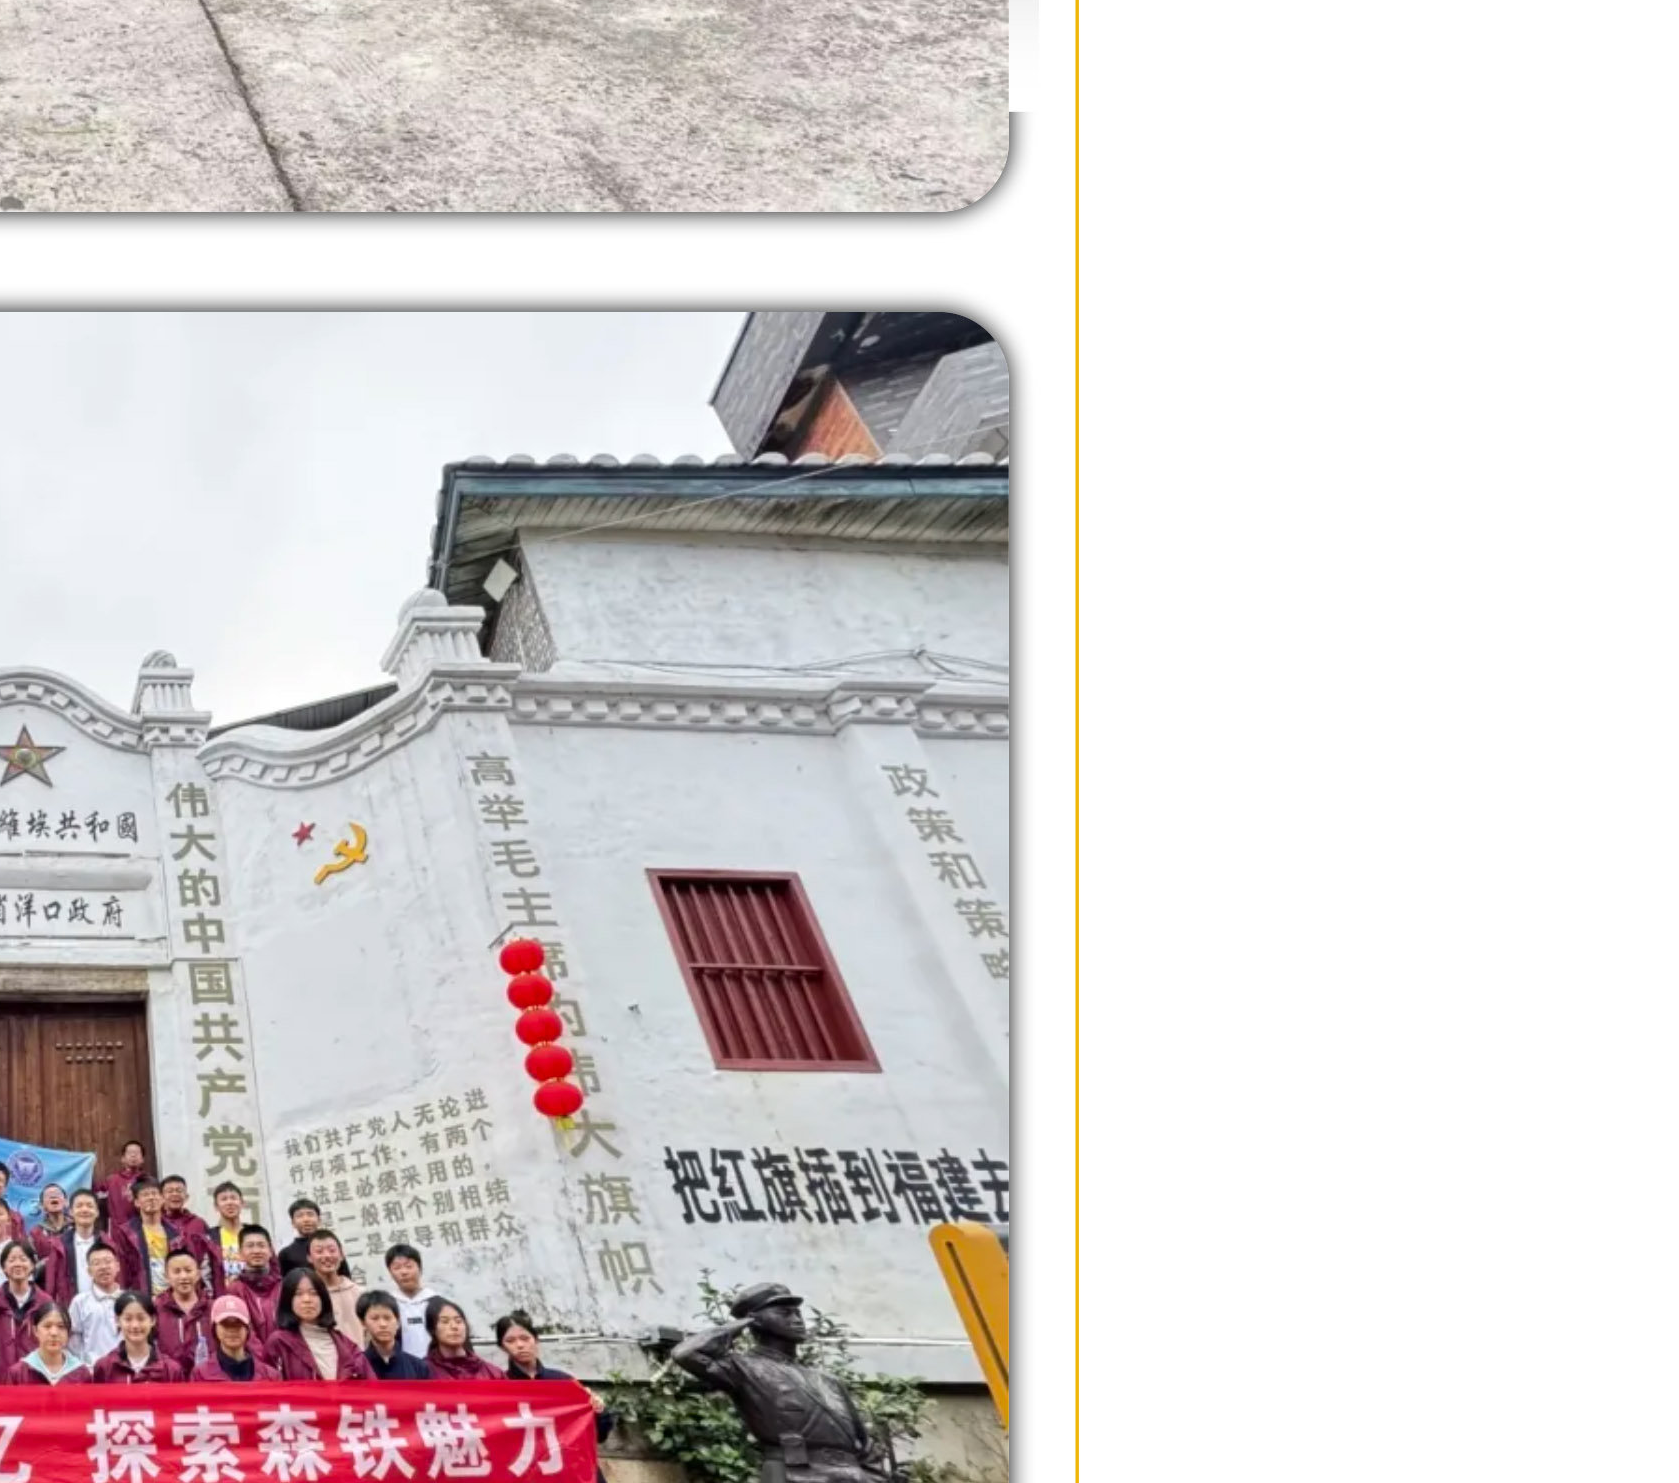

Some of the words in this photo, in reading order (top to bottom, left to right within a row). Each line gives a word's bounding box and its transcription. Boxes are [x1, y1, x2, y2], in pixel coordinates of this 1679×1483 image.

[285, 1087, 489, 1159] 我们共产党人无论进
[86, 1402, 570, 1483] 探索森铁魅力
